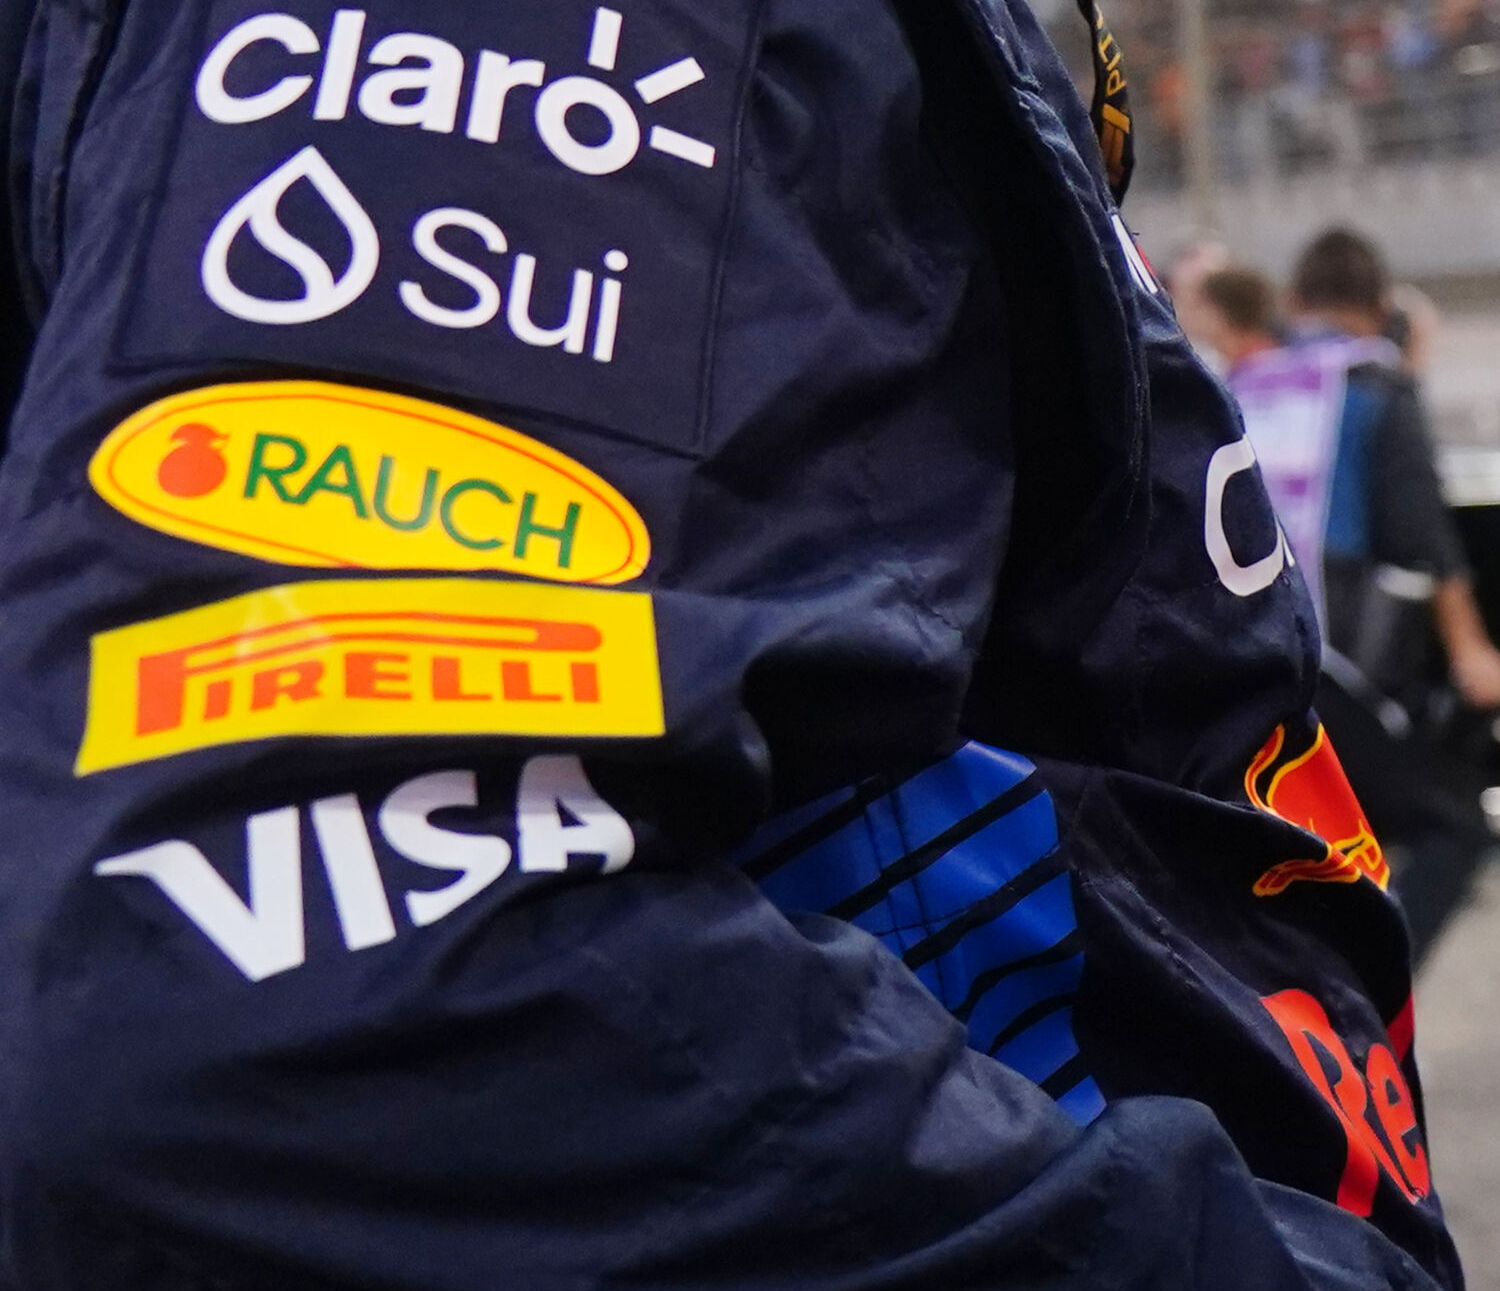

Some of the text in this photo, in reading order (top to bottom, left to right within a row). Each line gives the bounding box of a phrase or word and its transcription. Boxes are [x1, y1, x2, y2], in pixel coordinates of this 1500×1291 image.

[197, 9, 640, 176] Claro
[399, 208, 628, 363] Sui
[243, 433, 582, 568] RAUCH
[135, 612, 603, 737] PIRELLI
[95, 755, 635, 983] VISA
